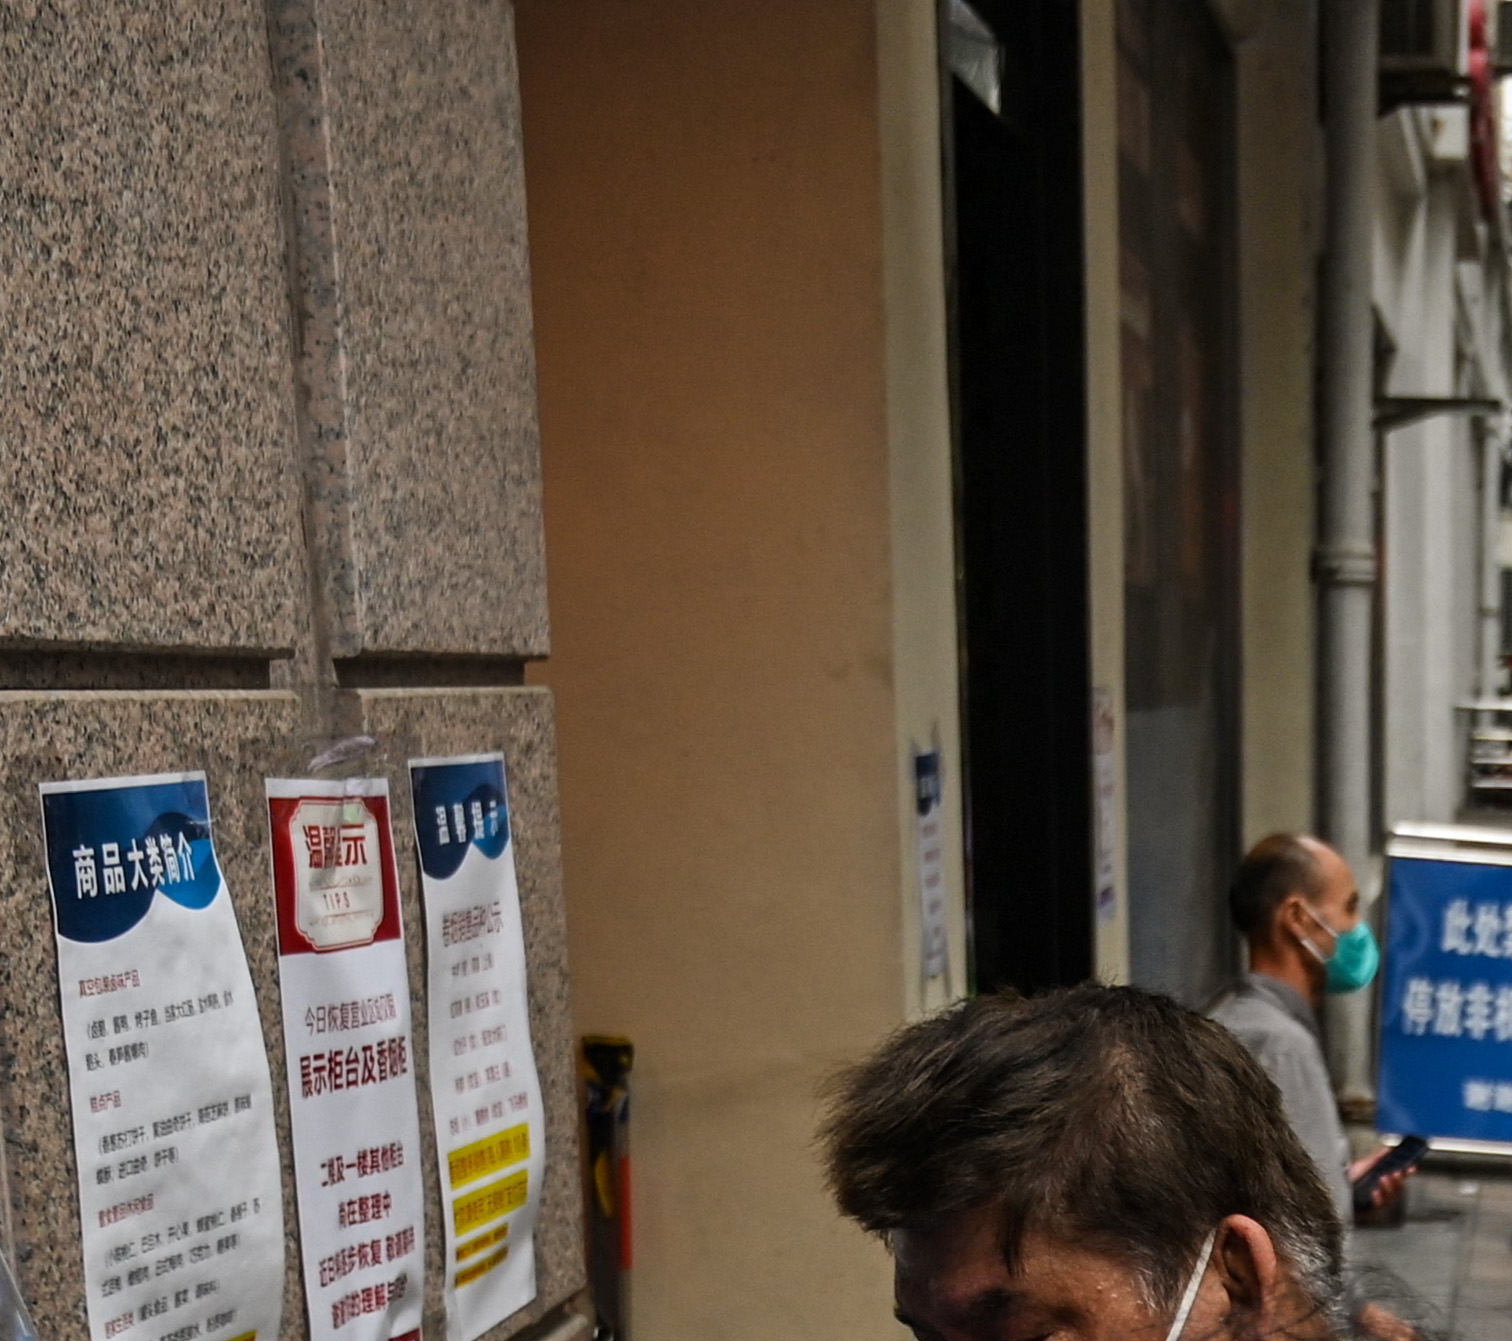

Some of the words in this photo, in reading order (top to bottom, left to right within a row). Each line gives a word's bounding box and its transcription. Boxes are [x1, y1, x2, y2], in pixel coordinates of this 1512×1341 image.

[73, 831, 195, 899] 商品大类简介
[323, 891, 351, 912] TIPS
